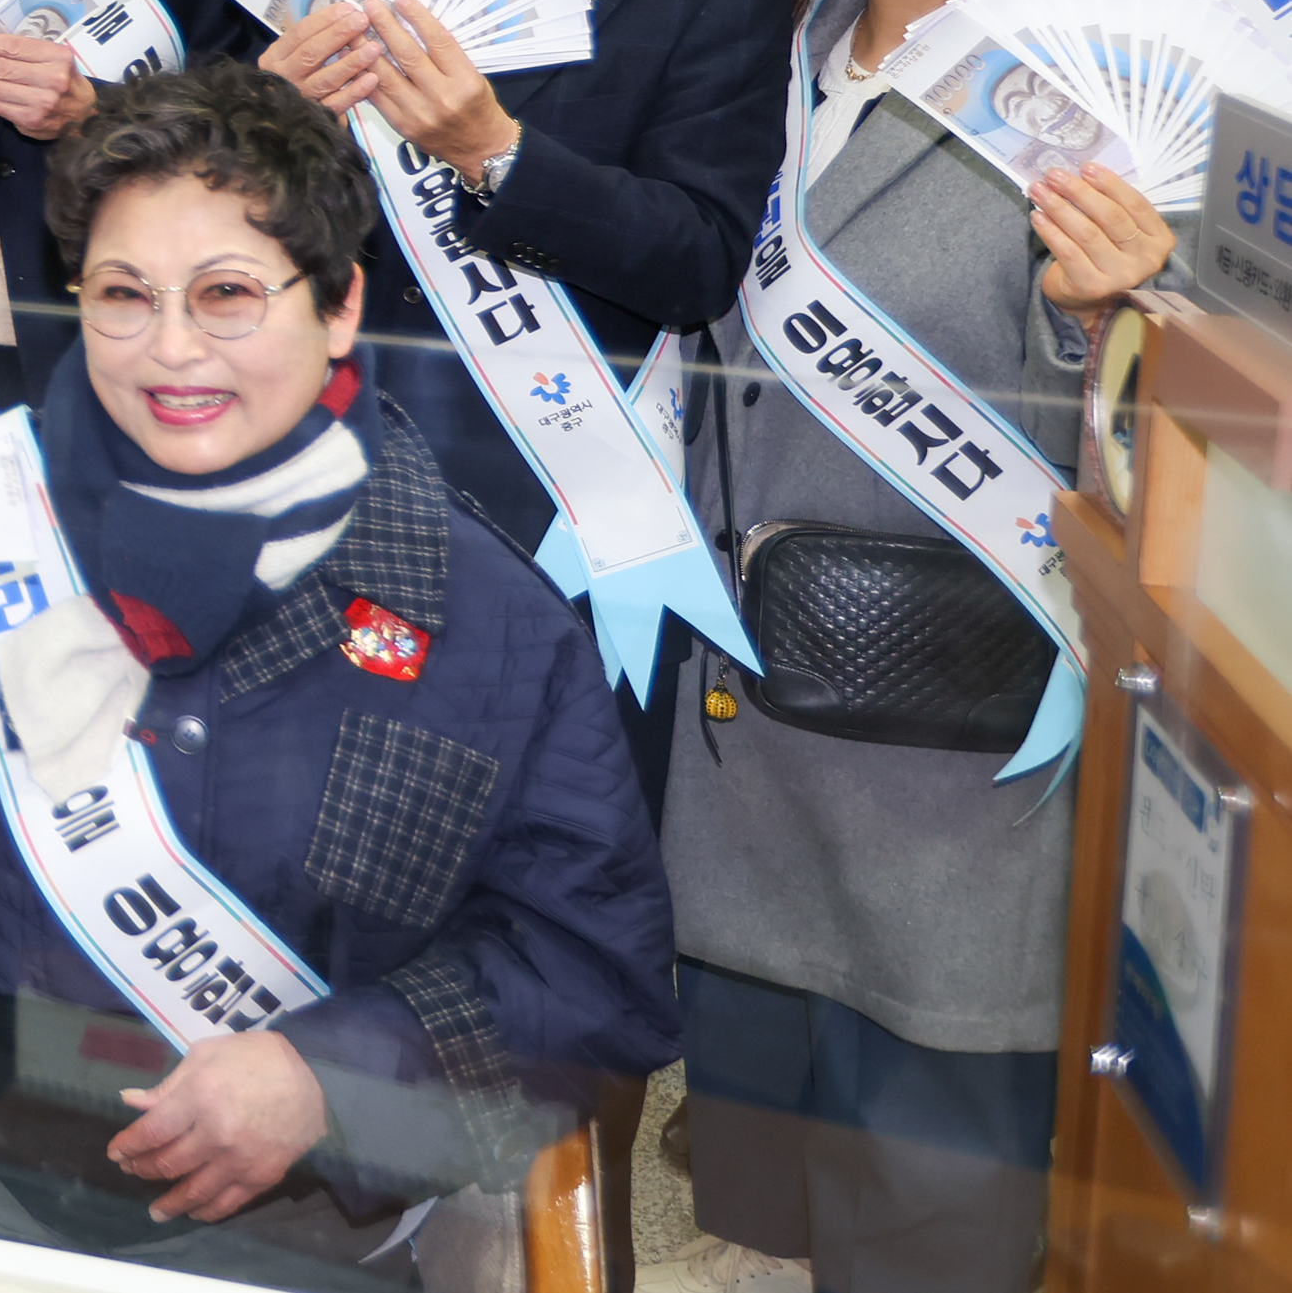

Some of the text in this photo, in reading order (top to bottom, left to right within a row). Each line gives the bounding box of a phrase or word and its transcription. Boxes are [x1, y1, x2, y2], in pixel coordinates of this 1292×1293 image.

[925, 53, 986, 107] 10000
[538, 399, 593, 428] 대구광역시
[783, 299, 1003, 501] 이용합시다
[561, 417, 583, 432] 중구
